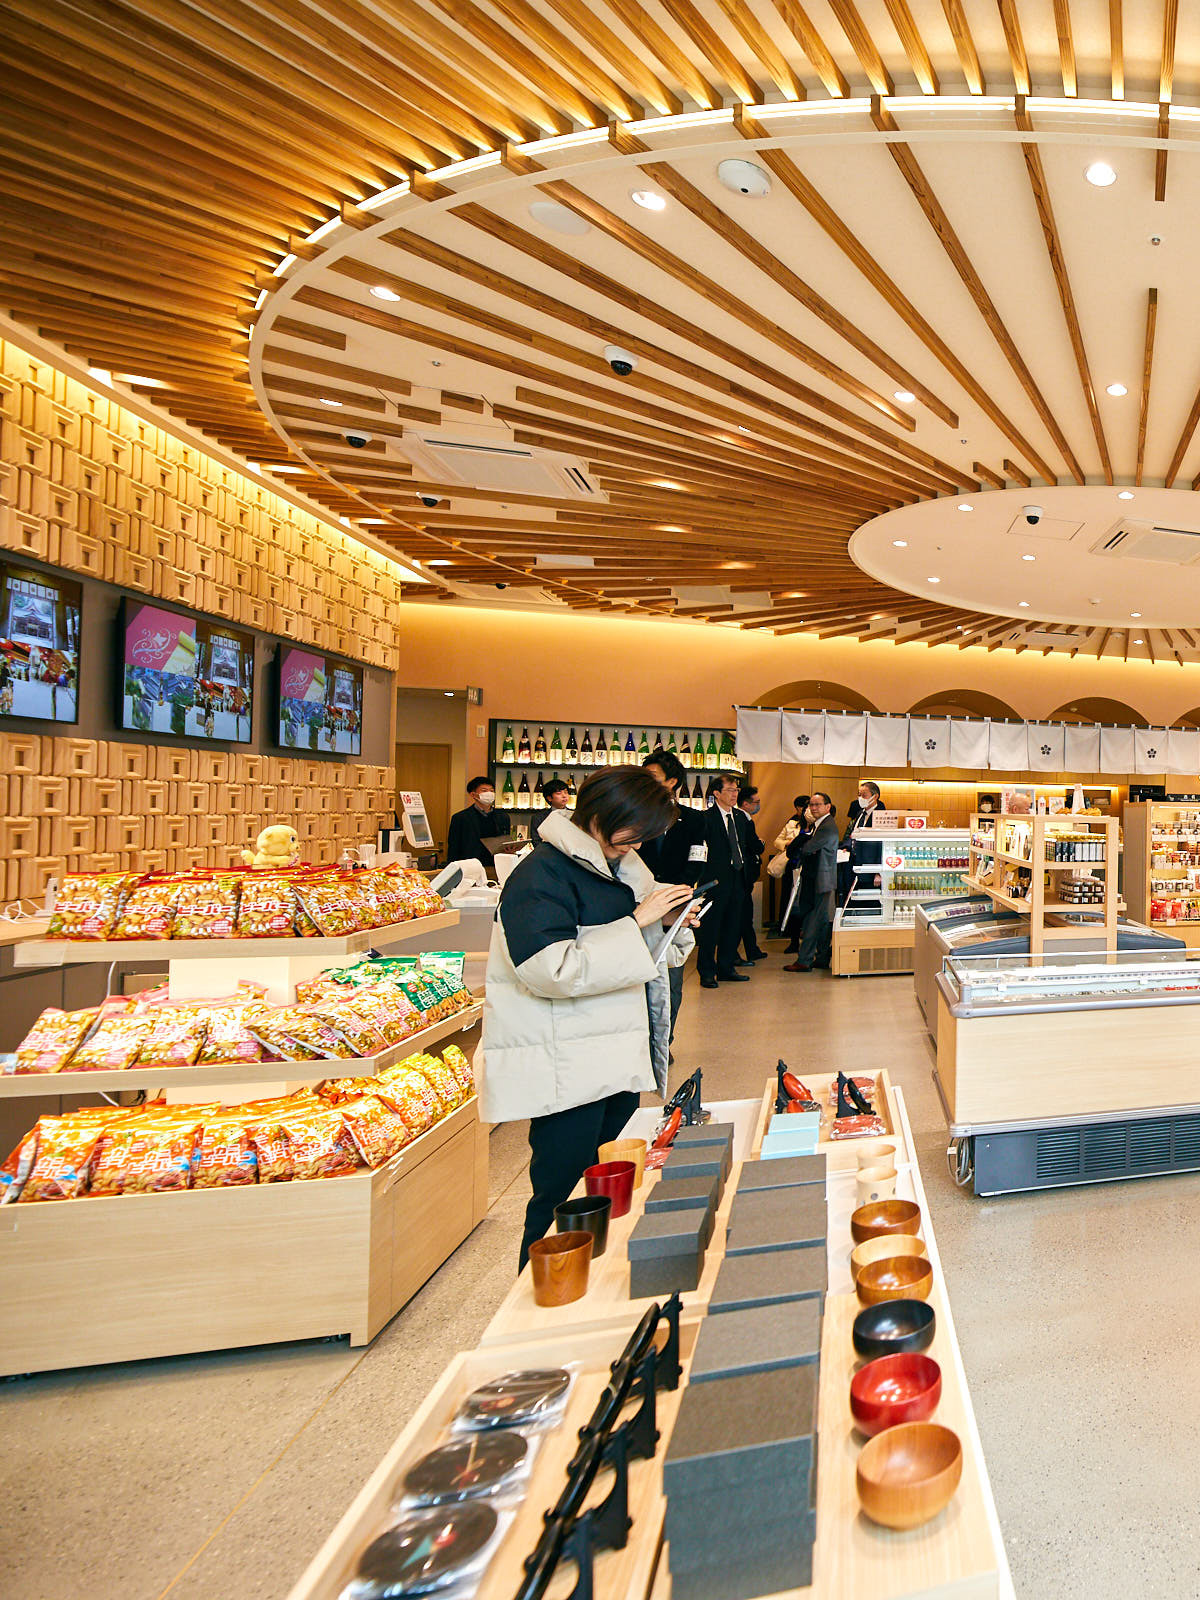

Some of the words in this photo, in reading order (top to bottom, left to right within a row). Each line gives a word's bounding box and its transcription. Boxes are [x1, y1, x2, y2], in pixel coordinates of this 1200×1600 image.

[53, 901, 102, 913] ビーバー
[123, 904, 172, 915] ビーバー
[177, 903, 232, 916] ビーバー
[241, 900, 291, 914] ビーバー
